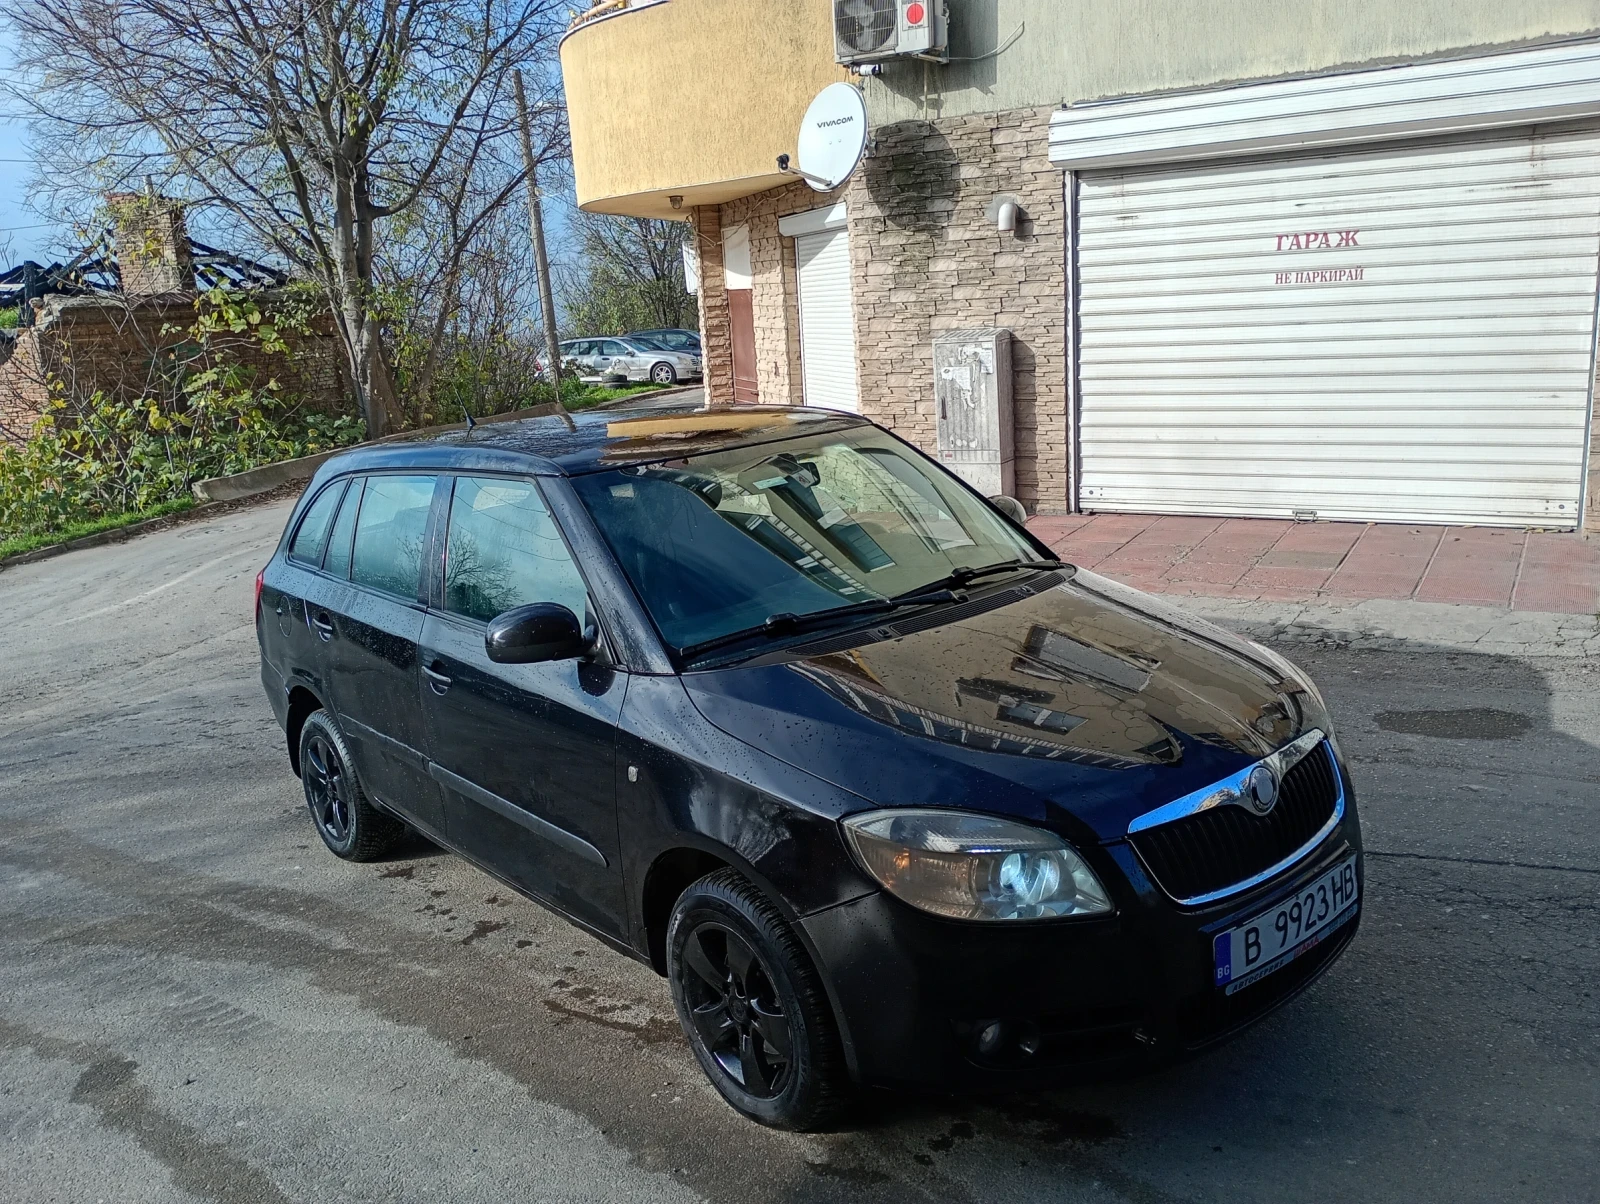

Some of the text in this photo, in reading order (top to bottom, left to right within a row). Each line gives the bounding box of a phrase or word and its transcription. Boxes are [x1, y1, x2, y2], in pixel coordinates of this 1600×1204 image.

[817, 116, 854, 129] VIVACOM
[1275, 229, 1360, 251] ГАРАЖ
[1275, 265, 1364, 285] НЕ ПАРКИРАЙ
[1244, 926, 1262, 967] B
[1217, 964, 1230, 979] BG
